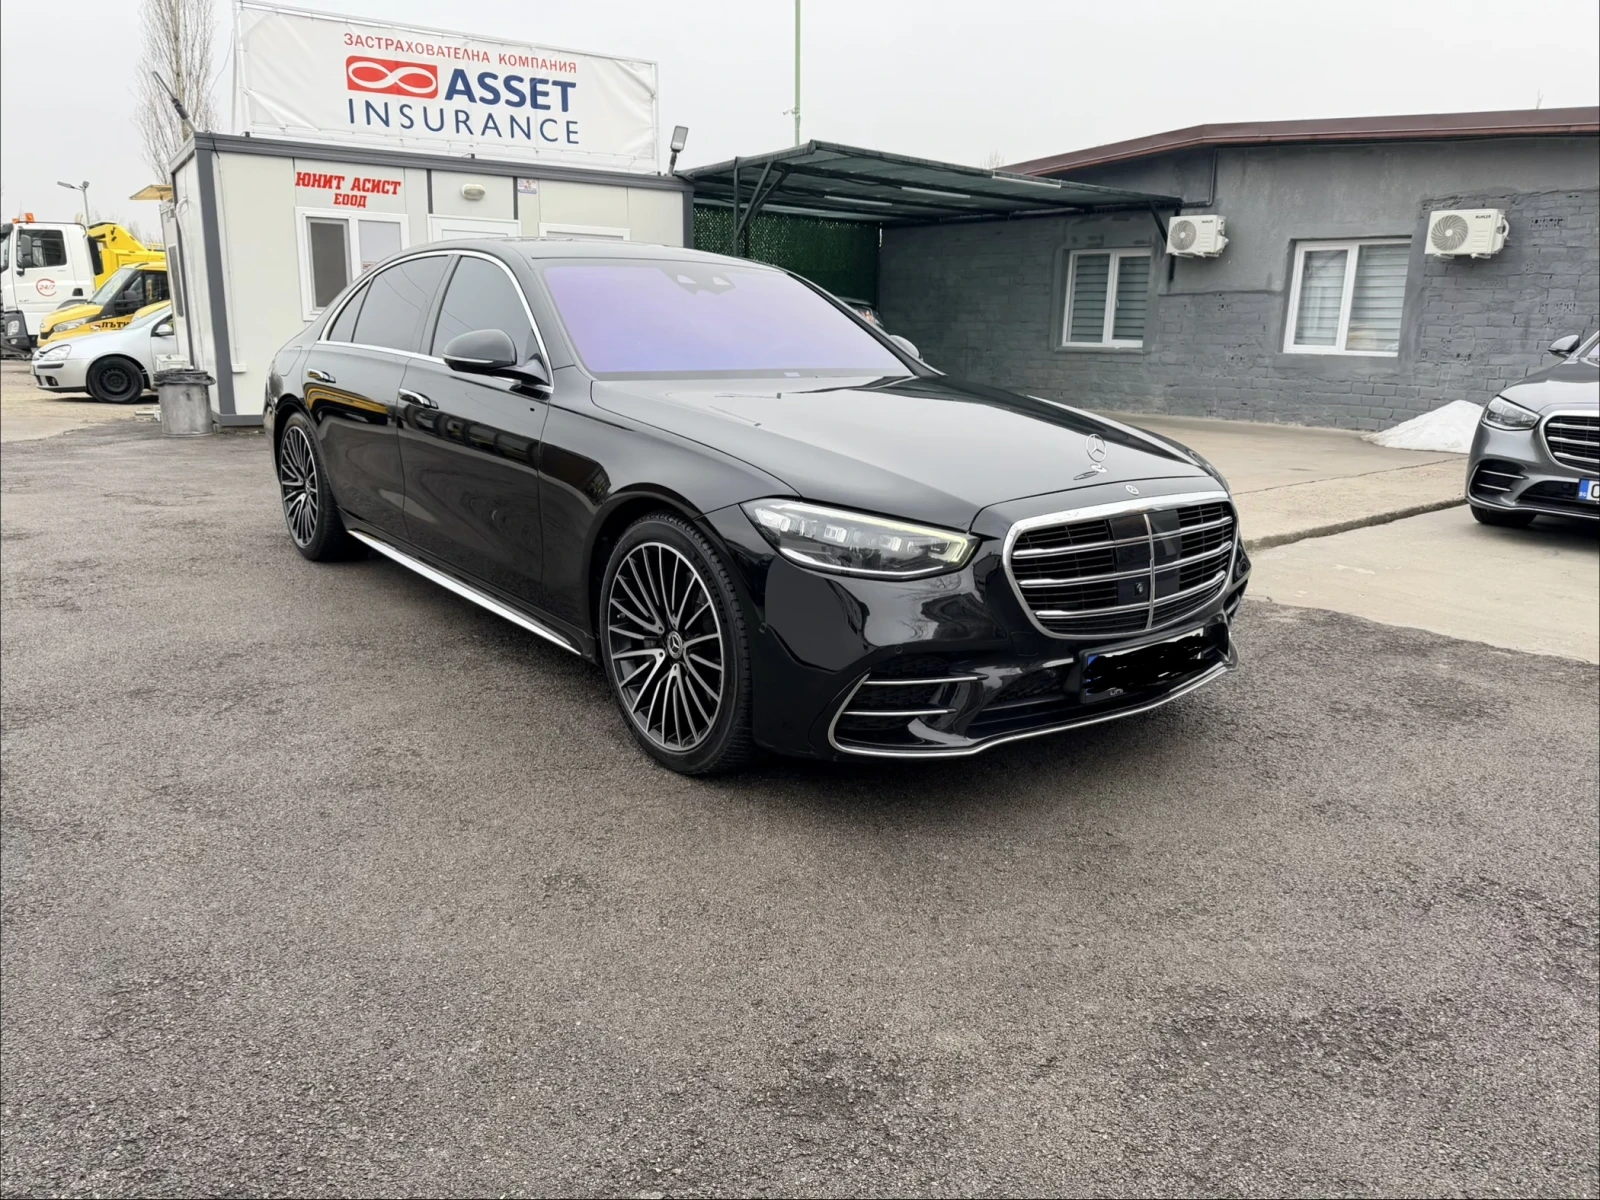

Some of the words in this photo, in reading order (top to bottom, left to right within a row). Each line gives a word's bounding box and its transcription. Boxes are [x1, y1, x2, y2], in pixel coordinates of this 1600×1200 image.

[344, 33, 490, 63] ЗАСТРАХОВАТЕЛНА
[498, 53, 577, 73] КОМПАНИЯ
[444, 68, 577, 112] ASSET
[348, 98, 580, 144] INSURANCE
[295, 172, 345, 190] ЮНИТ
[350, 177, 401, 195] АСИСТ
[333, 193, 367, 208] ЕООД
